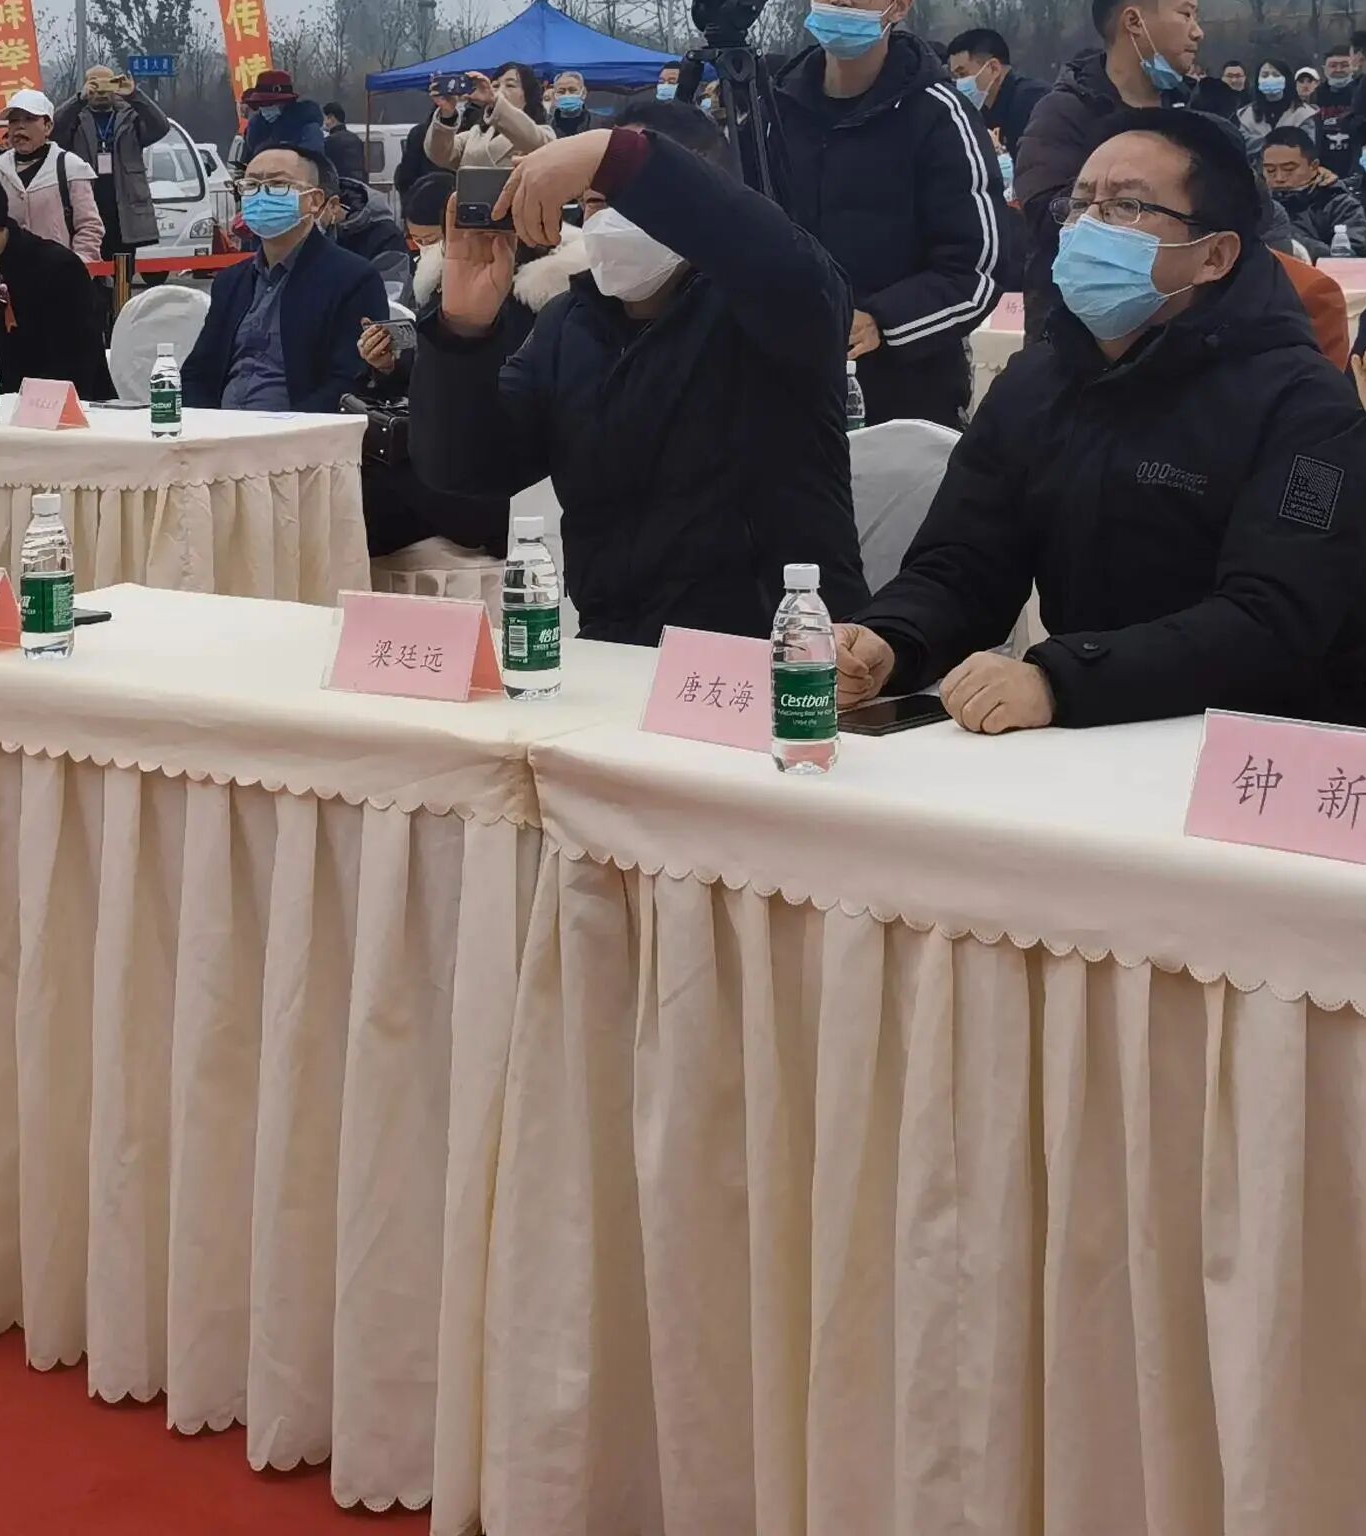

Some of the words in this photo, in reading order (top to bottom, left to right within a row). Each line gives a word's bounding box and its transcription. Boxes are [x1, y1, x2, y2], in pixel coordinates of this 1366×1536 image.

[367, 639, 444, 673] 梁廷远
[675, 671, 755, 713] 唐友海
